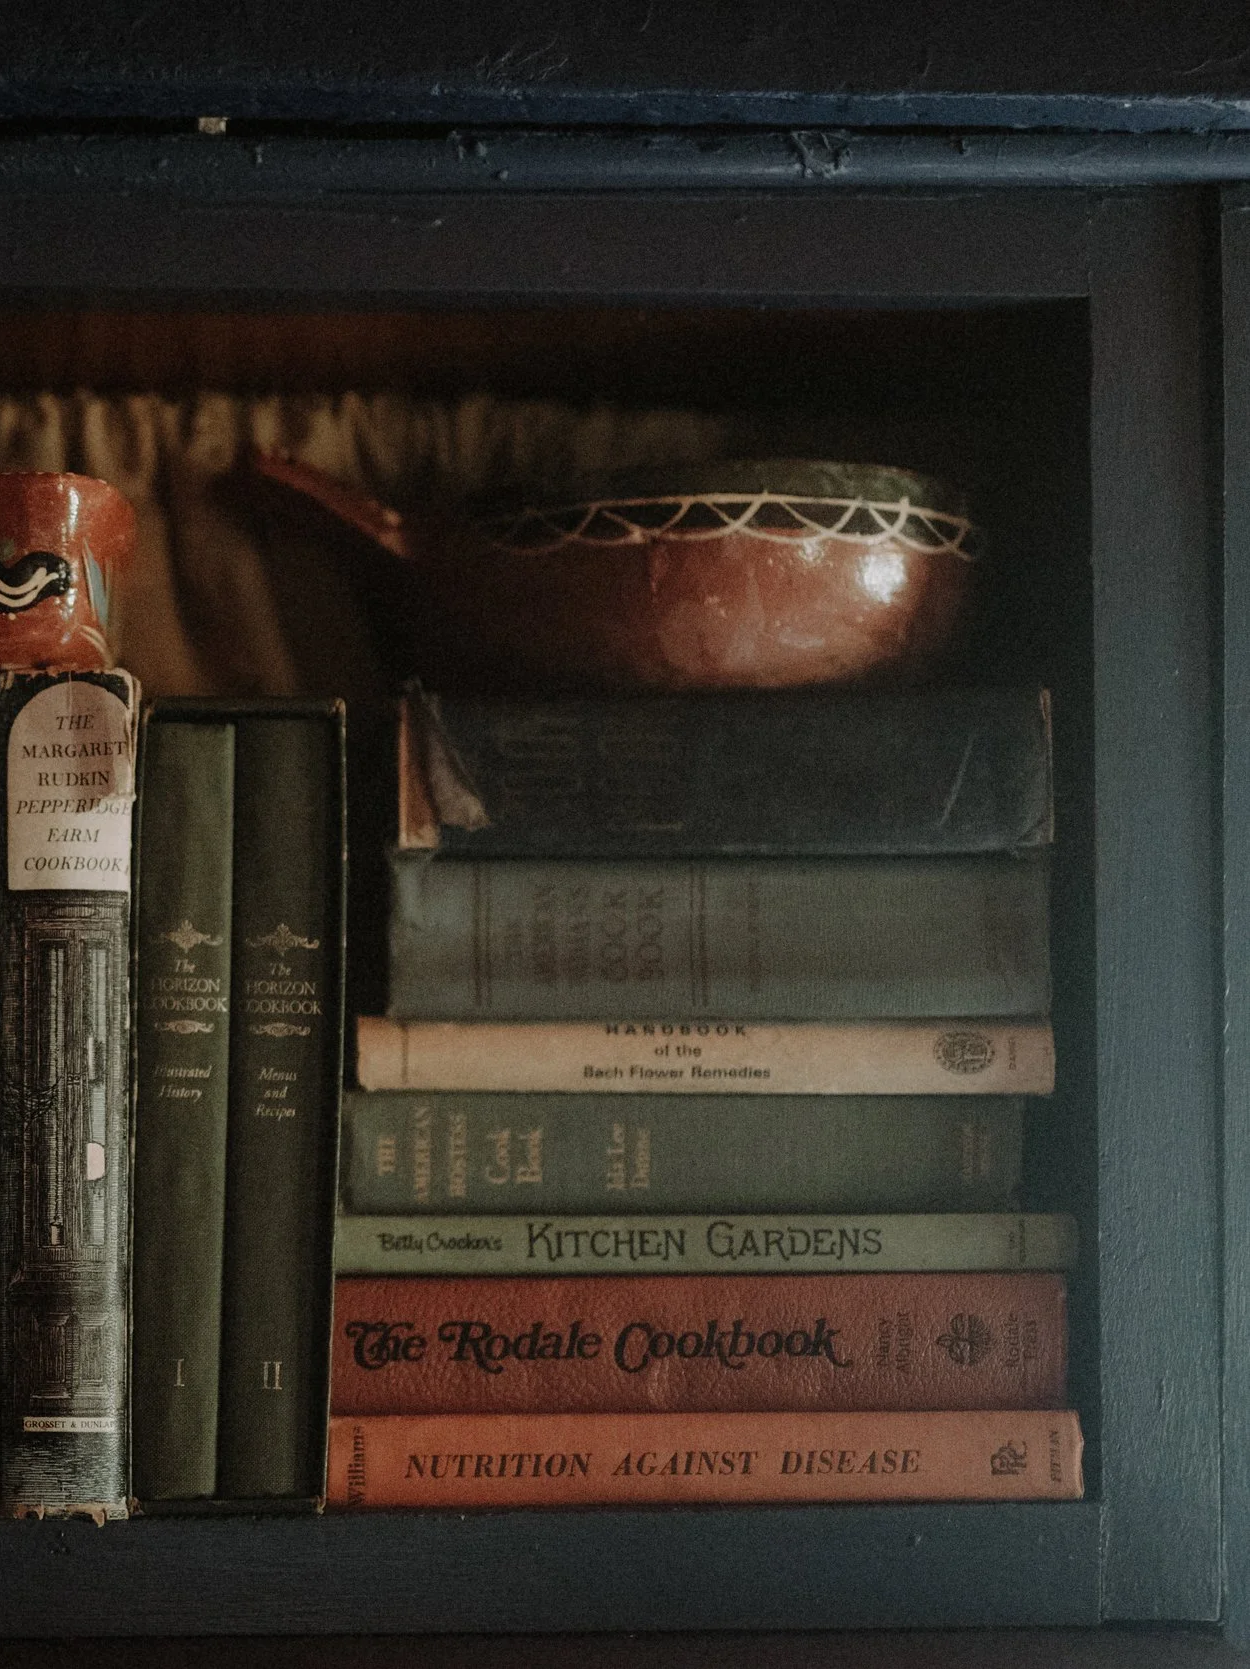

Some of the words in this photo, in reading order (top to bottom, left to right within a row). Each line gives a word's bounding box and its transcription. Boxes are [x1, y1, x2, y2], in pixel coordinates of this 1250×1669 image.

[56, 714, 95, 731] THE
[22, 740, 127, 760] MARGARET
[38, 770, 111, 787] RUDKIN
[47, 828, 100, 843] FARM
[24, 856, 124, 872] COOKBOOK
[174, 959, 196, 974] The
[270, 962, 292, 977] The
[151, 977, 222, 993] HORIZON
[247, 980, 317, 996] HORIZON
[605, 1023, 747, 1037] HANDBOOK
[655, 1045, 669, 1057] of
[677, 1045, 702, 1058] the
[258, 1066, 298, 1082] Menus
[583, 1065, 623, 1079] Bach
[630, 1065, 685, 1079] Flower
[691, 1065, 771, 1079] Remedies
[264, 1085, 288, 1099] and
[255, 1102, 297, 1121] Recipes
[377, 1232, 423, 1254] Betty
[526, 1222, 687, 1262] KITCHEN
[705, 1219, 883, 1261] GARDENS
[345, 1320, 427, 1372] The
[438, 1319, 604, 1374] Rodale
[614, 1317, 854, 1374] Cookbook
[260, 1360, 283, 1391] II
[25, 1420, 67, 1429] GROSSET
[70, 1420, 78, 1429] &
[404, 1453, 593, 1479] NUTRITION
[610, 1450, 759, 1477] AGAINST
[779, 1449, 921, 1475] DISEASE
